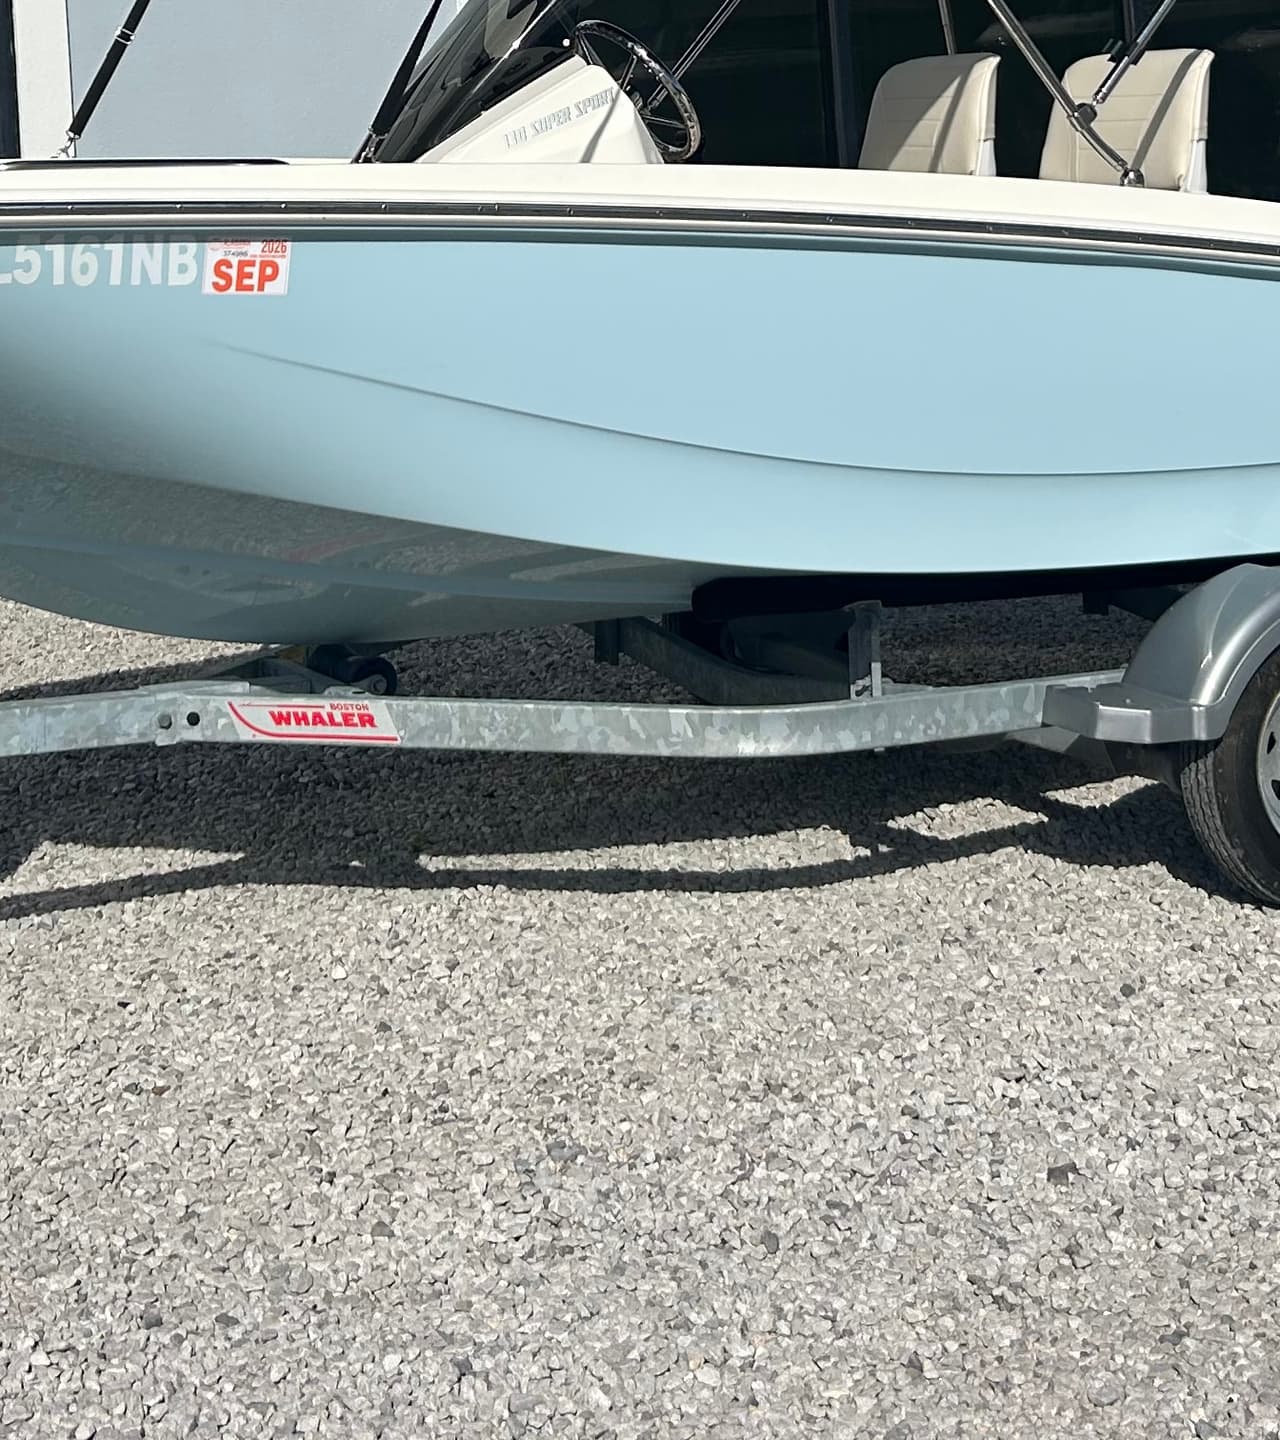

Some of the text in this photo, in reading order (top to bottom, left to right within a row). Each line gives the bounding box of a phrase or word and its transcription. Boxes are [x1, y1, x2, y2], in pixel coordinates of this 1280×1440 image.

[529, 106, 572, 137] SUPER
[573, 86, 616, 119] SPORT
[261, 239, 288, 253] 2026
[211, 258, 280, 293] SEP
[328, 702, 370, 711] BOSTON
[268, 710, 378, 728] WHALER
